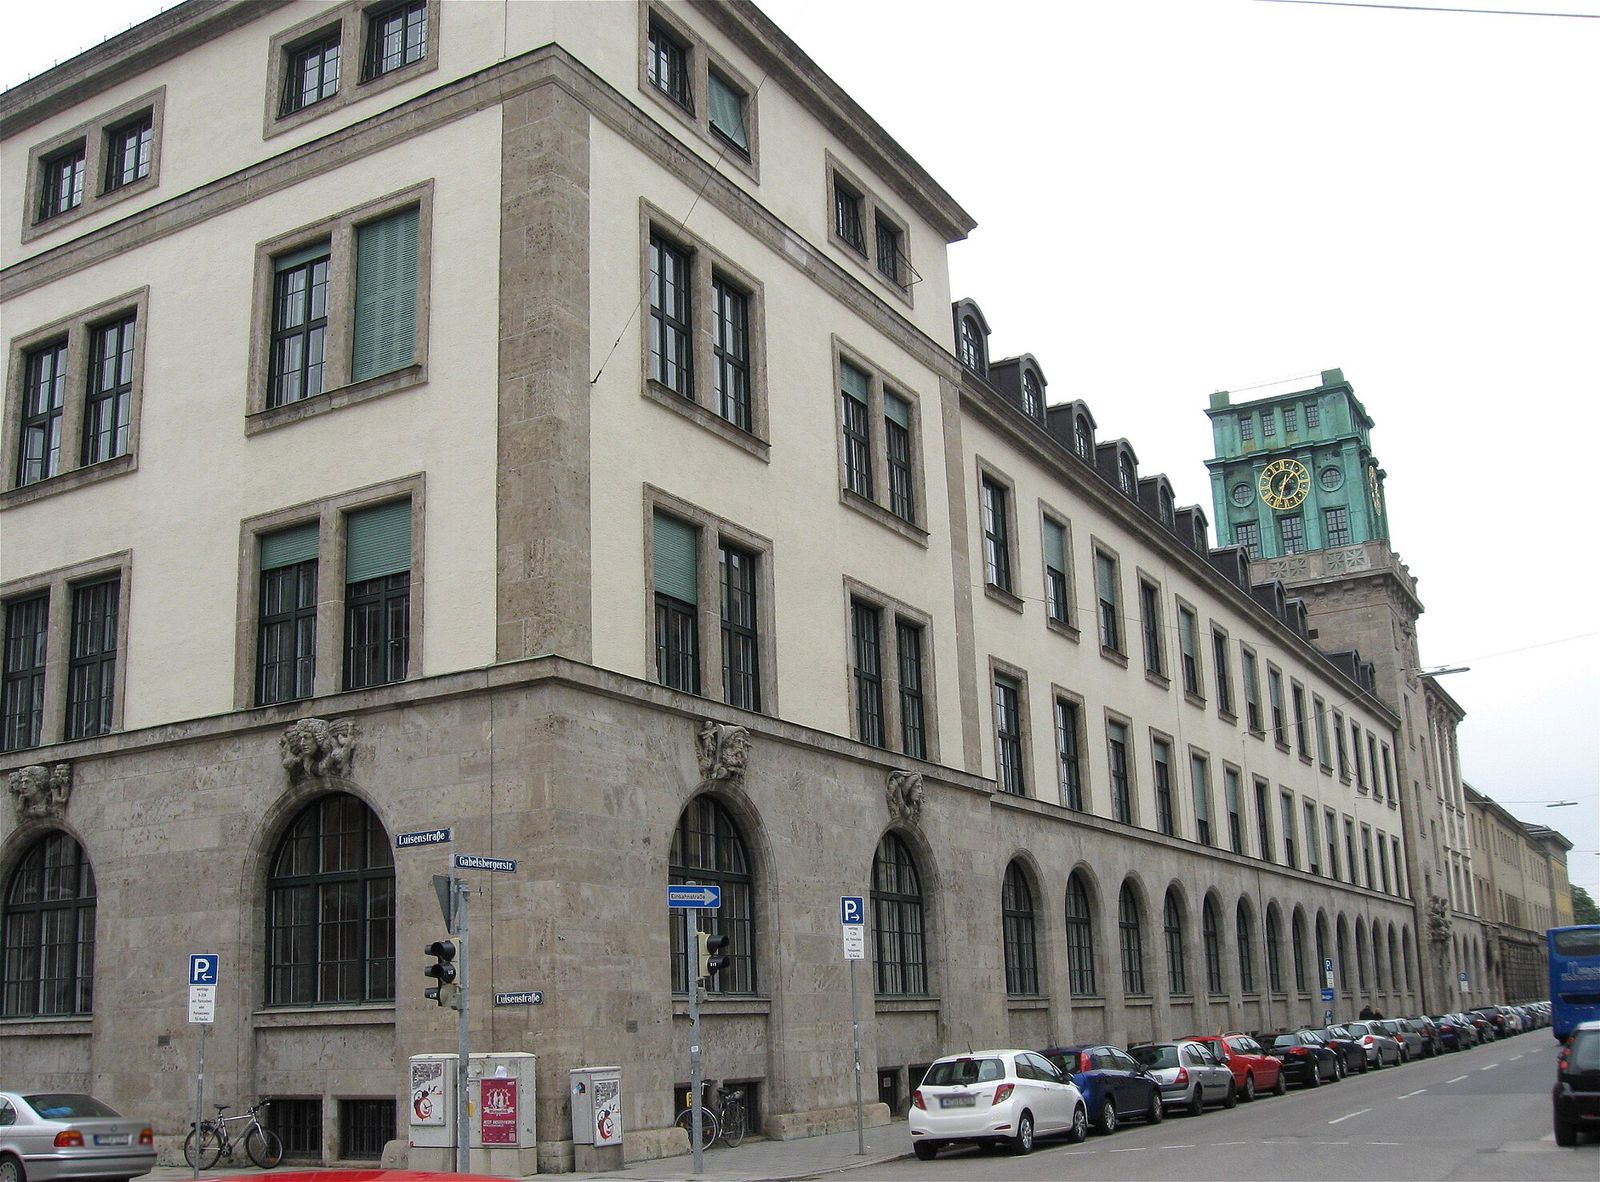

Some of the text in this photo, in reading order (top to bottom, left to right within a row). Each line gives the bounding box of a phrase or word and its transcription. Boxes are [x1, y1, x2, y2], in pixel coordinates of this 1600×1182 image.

[398, 831, 445, 845] Luisenstraße
[459, 856, 513, 871] Gabelsbergerstr.
[844, 900, 857, 921] P
[194, 958, 210, 981] P
[496, 993, 541, 1004] Luisenstraße
